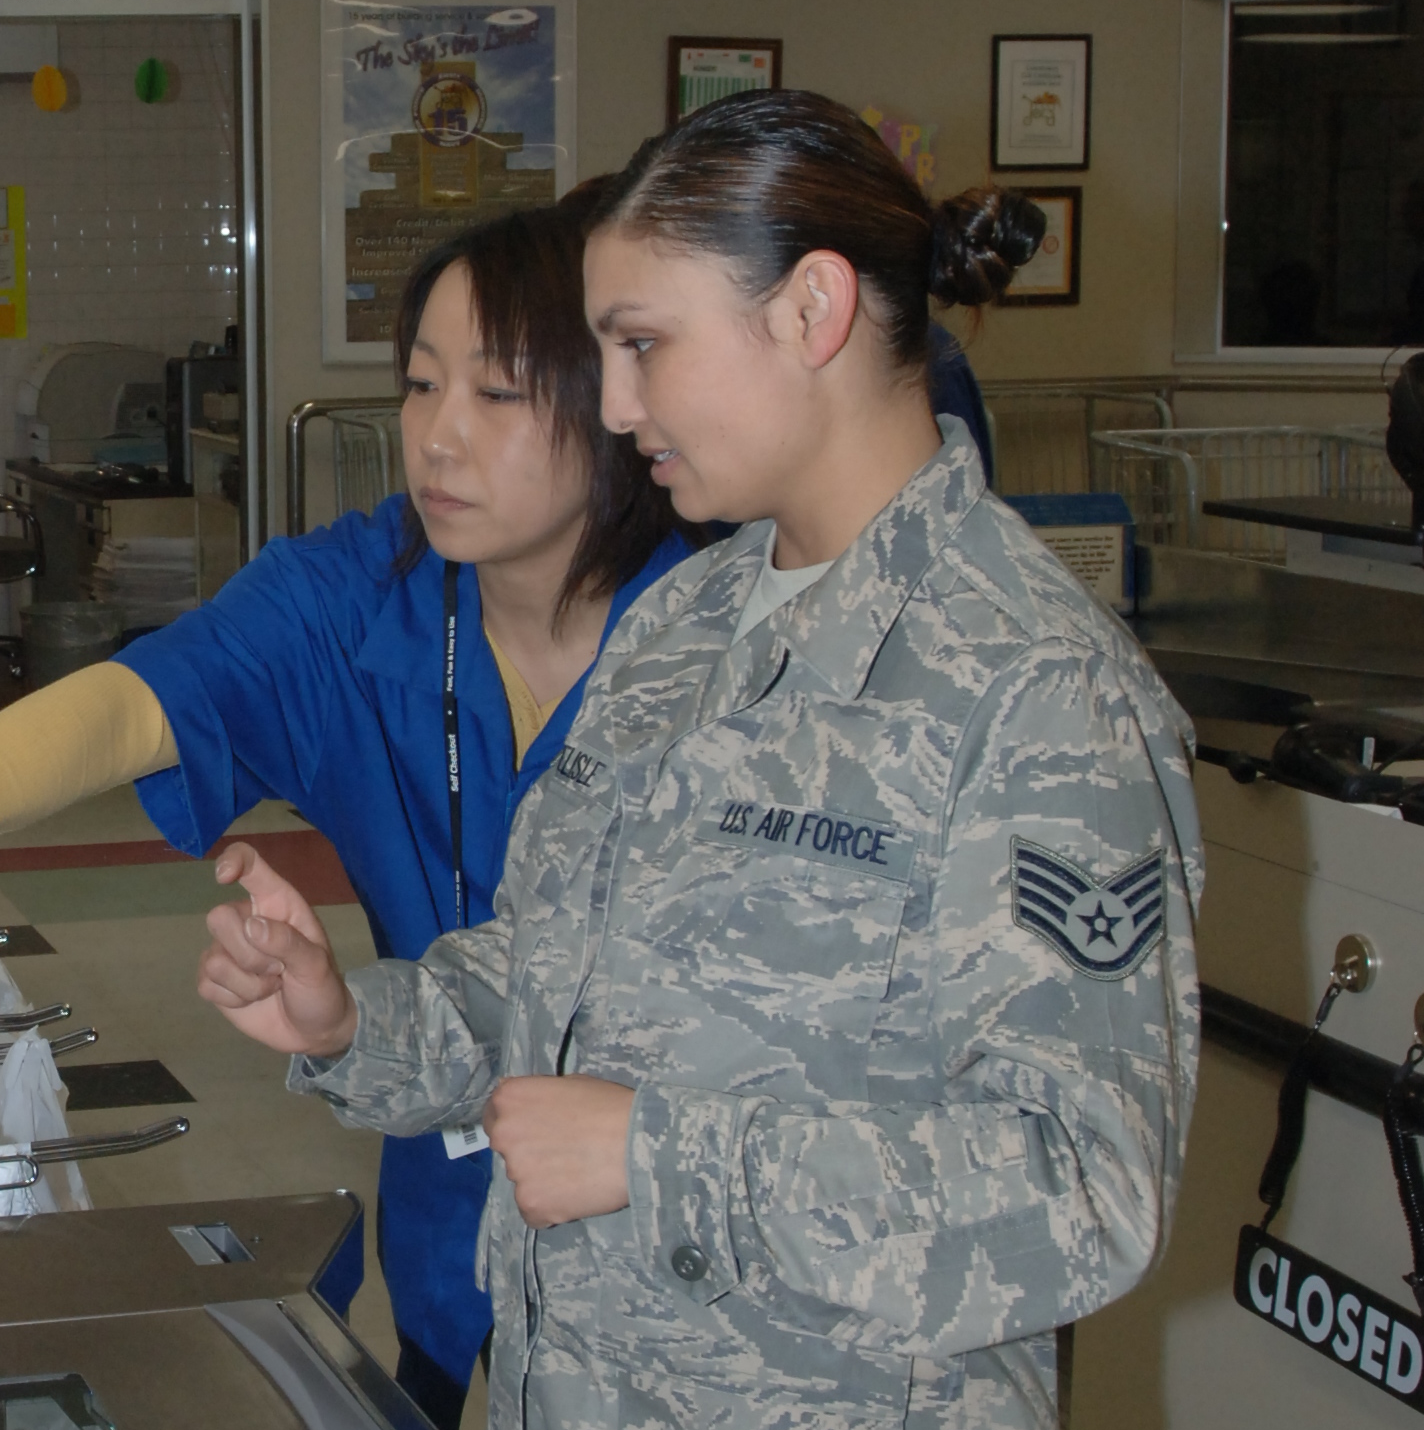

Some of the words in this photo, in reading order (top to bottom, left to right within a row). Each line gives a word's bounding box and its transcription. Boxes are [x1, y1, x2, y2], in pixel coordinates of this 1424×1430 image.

[356, 39, 393, 72] The
[427, 107, 468, 137] 15
[447, 733, 459, 774] Checkout
[449, 775, 460, 793] Self
[719, 802, 754, 836] U.S.
[754, 807, 795, 843] AIR
[795, 813, 895, 866] FORCE
[1249, 1246, 1423, 1395] CLOSED
